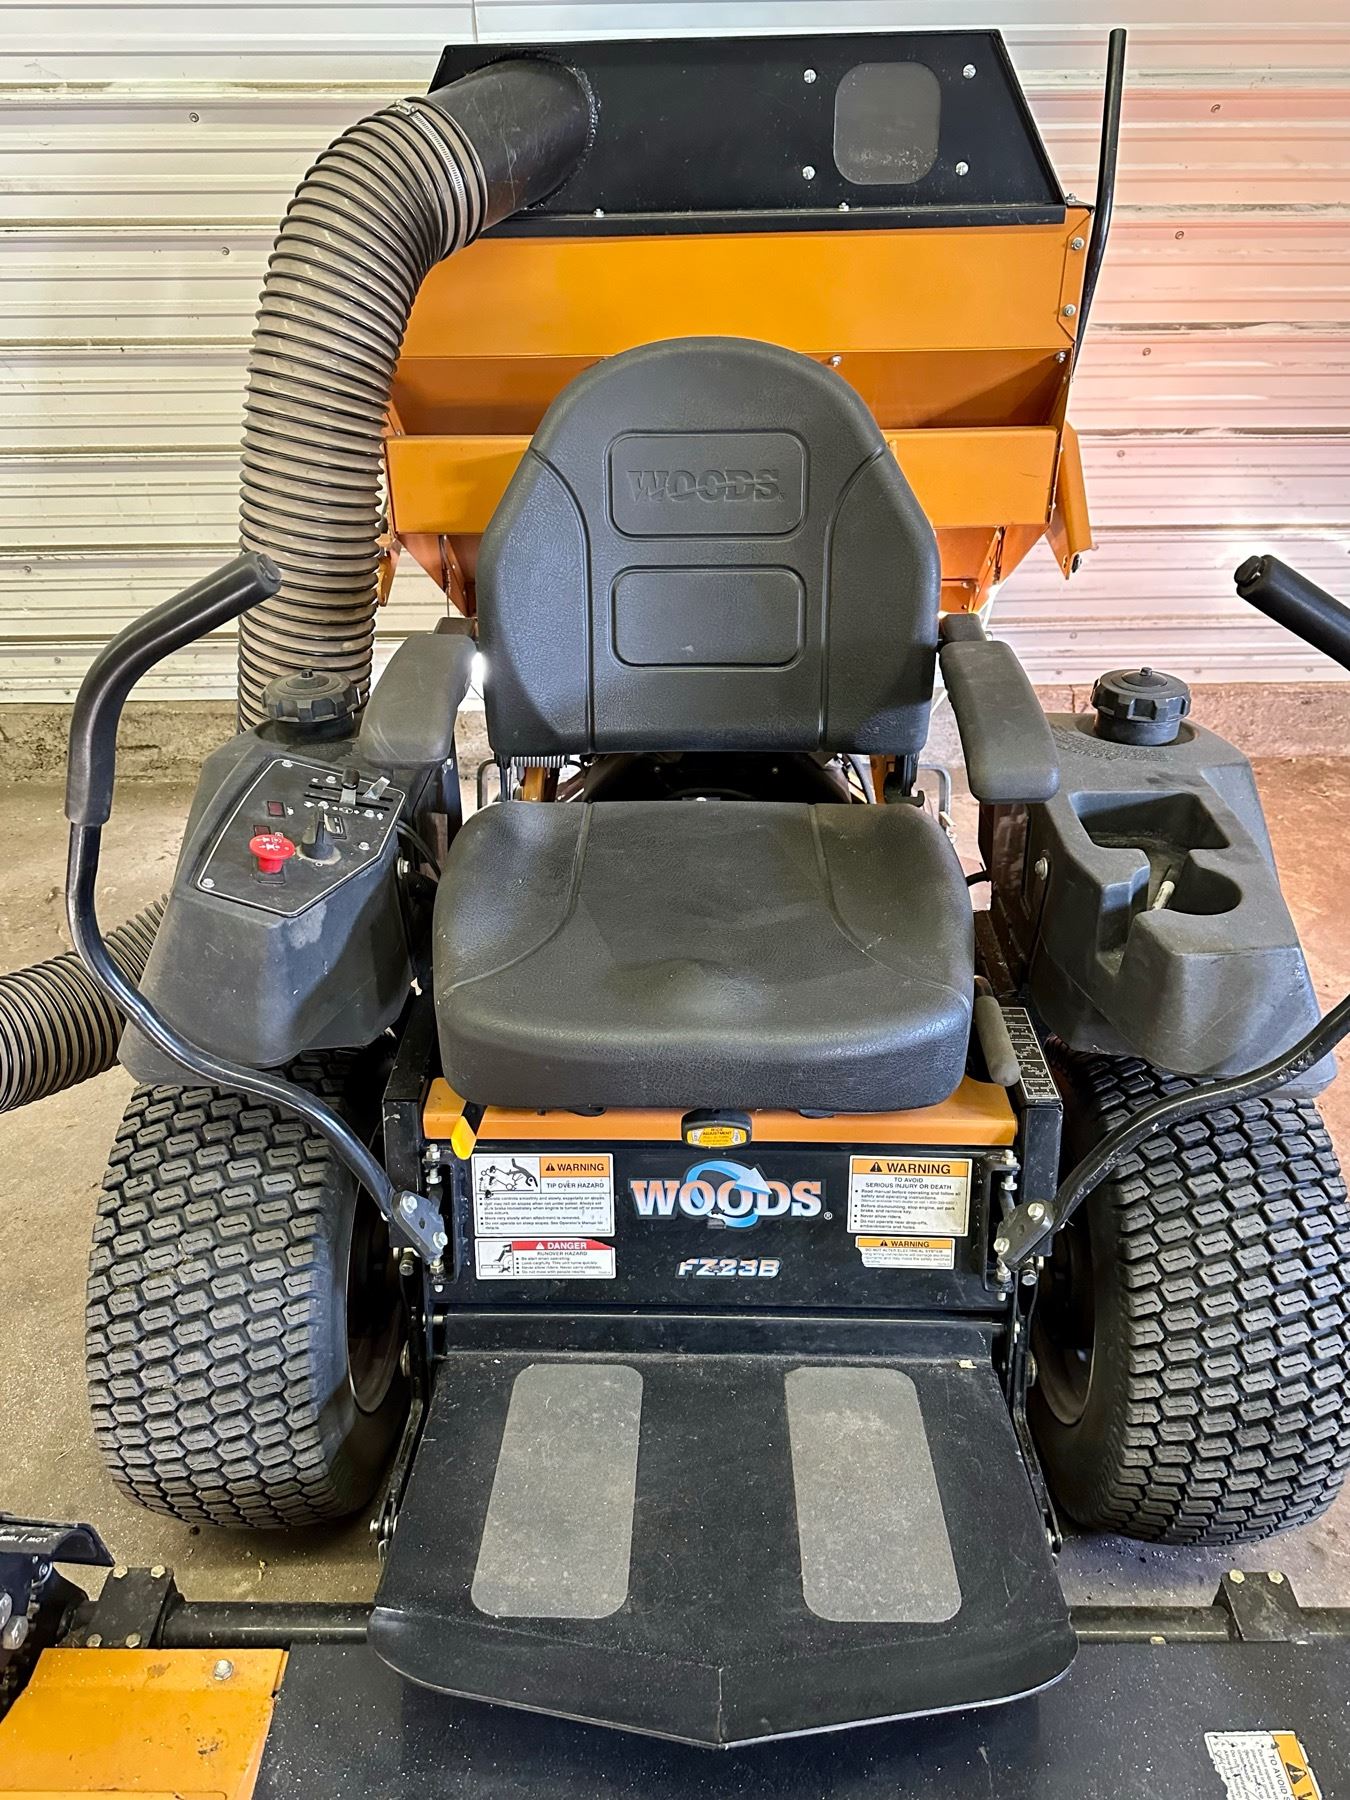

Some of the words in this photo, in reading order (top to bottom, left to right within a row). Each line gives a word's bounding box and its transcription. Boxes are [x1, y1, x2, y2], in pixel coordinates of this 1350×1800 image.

[628, 470, 780, 501] WOODS
[887, 1163, 950, 1174] WARNING
[630, 1180, 822, 1216] WOODS
[678, 1258, 781, 1277] FZ23B
[1269, 1754, 1277, 1766] TO
[1274, 1769, 1287, 1794] AVOID
